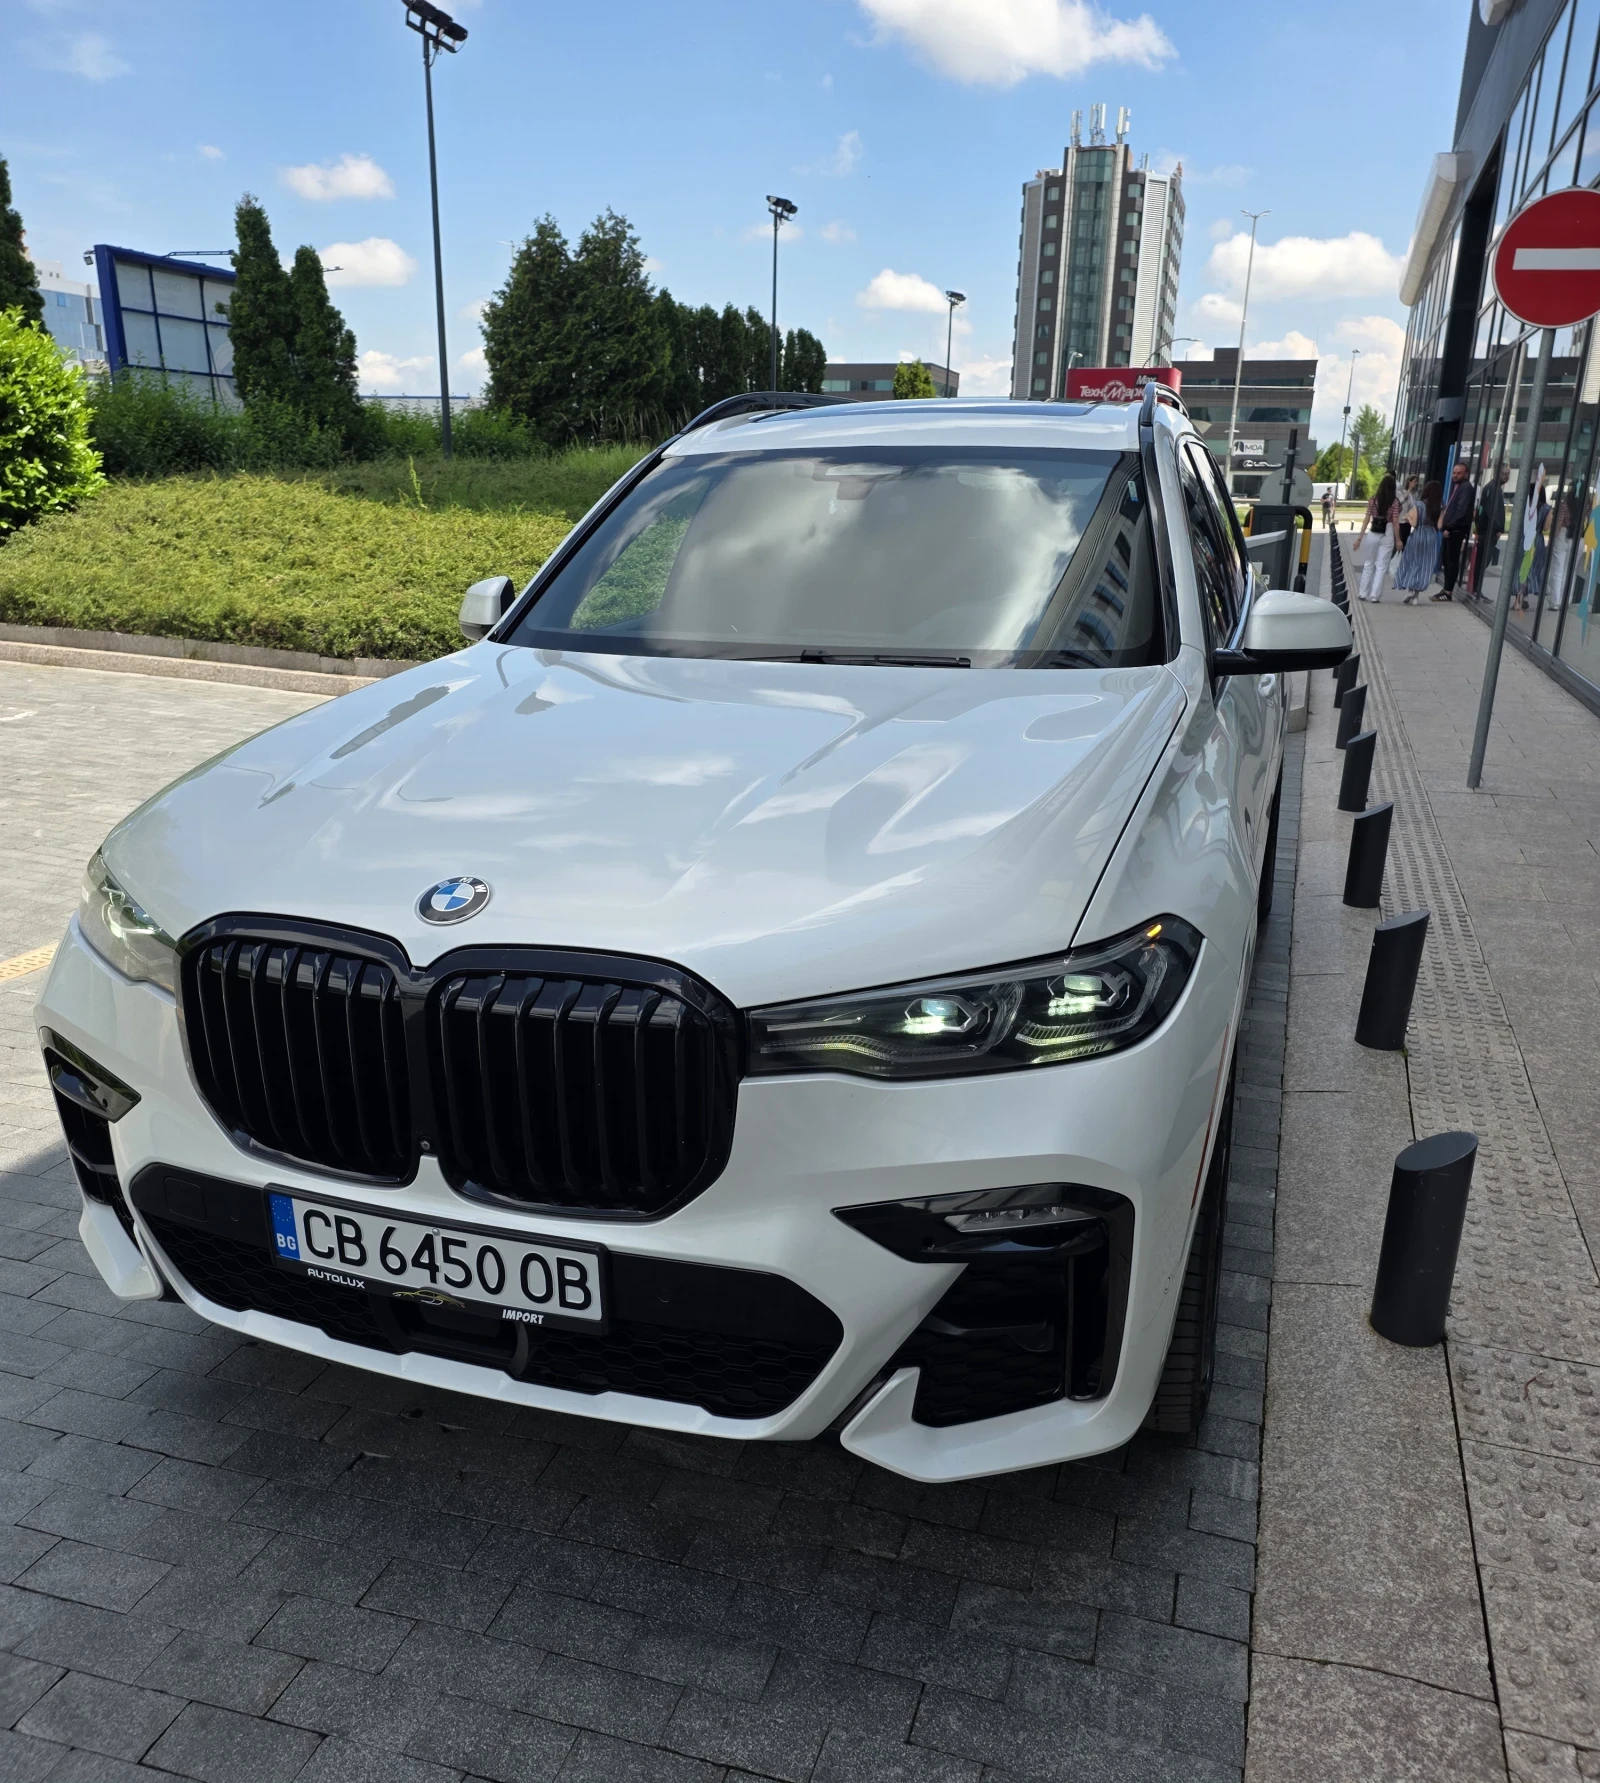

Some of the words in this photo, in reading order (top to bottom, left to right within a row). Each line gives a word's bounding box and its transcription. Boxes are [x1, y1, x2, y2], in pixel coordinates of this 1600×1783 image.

[276, 1233, 297, 1251] BG
[303, 1209, 367, 1267] CB
[380, 1227, 506, 1295] 6450
[520, 1253, 592, 1310] OB
[307, 1268, 366, 1289] AUTOLUX
[502, 1309, 544, 1325] IMPORT
